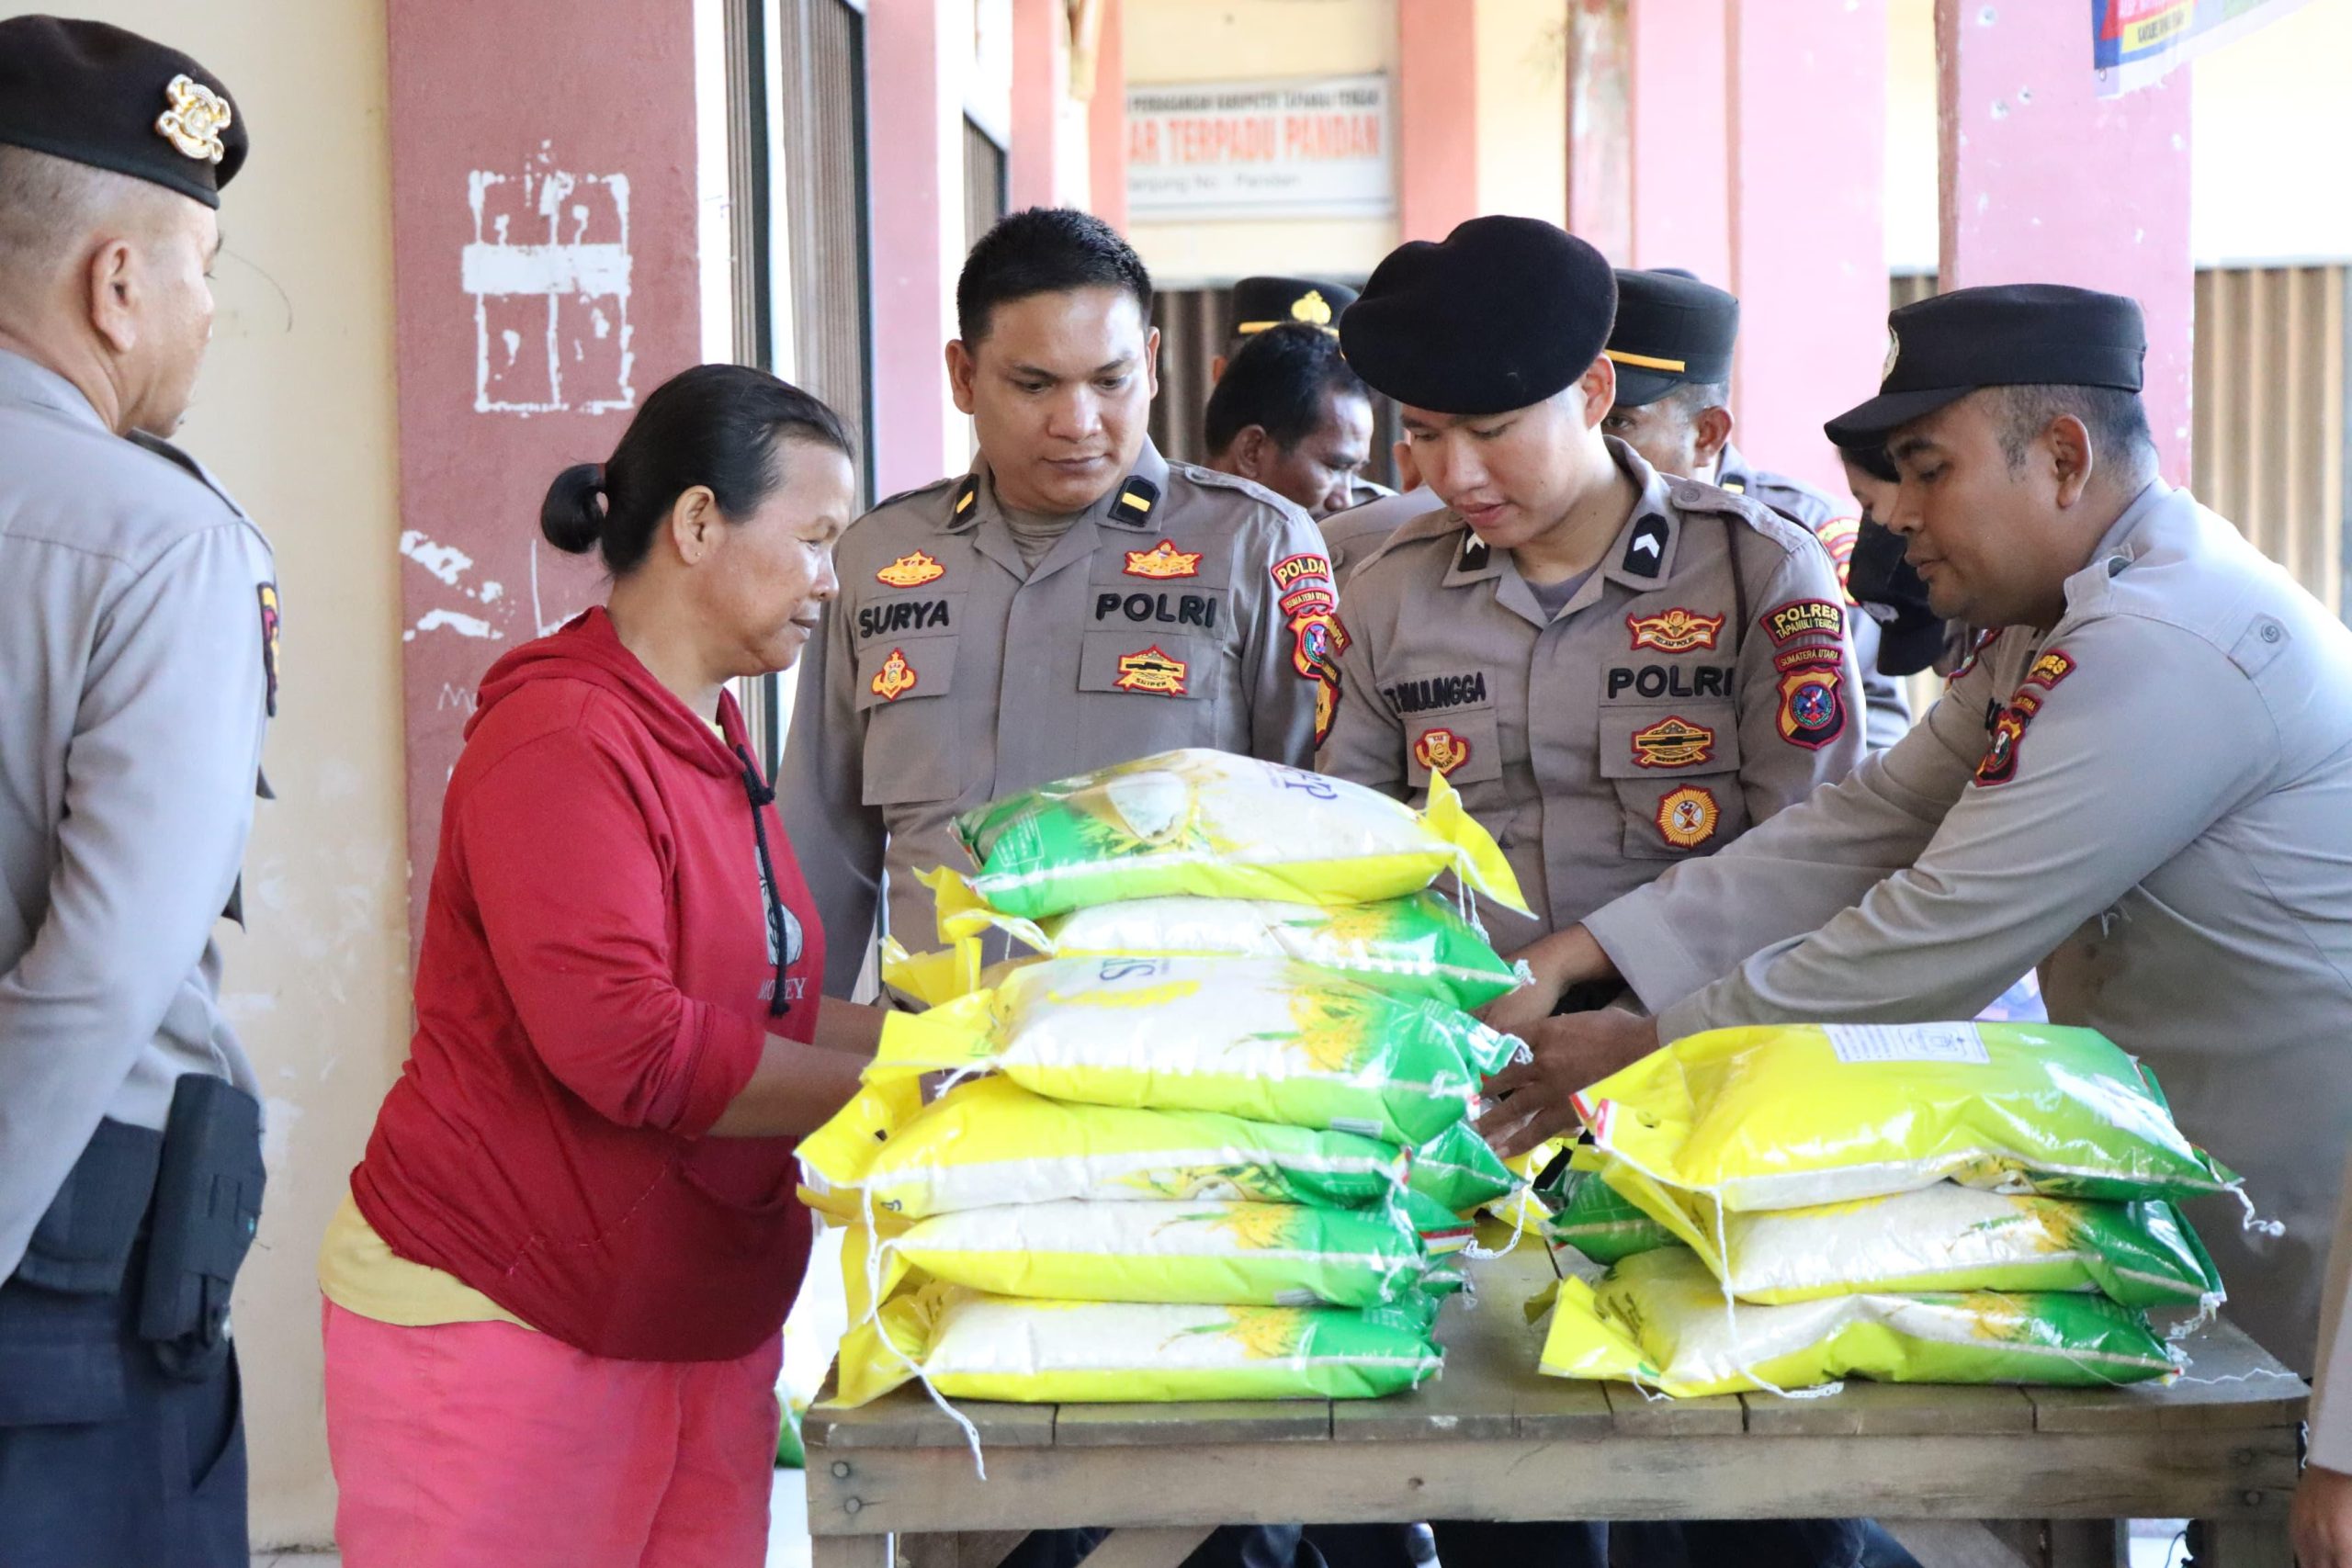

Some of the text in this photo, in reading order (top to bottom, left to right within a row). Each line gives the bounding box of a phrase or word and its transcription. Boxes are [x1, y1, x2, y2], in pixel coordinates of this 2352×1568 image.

[1168, 117, 1275, 163] TERPADU
[1284, 115, 1380, 159] PANDAN
[1277, 558, 1328, 583] POLDA
[859, 599, 950, 638] SURYA
[1096, 592, 1217, 628] POLRI
[1774, 604, 1839, 626] POLRES
[1781, 648, 1838, 668] SUMATERA UTARA
[1608, 664, 1735, 699] POLRI
[757, 977, 807, 1000] MOEY
